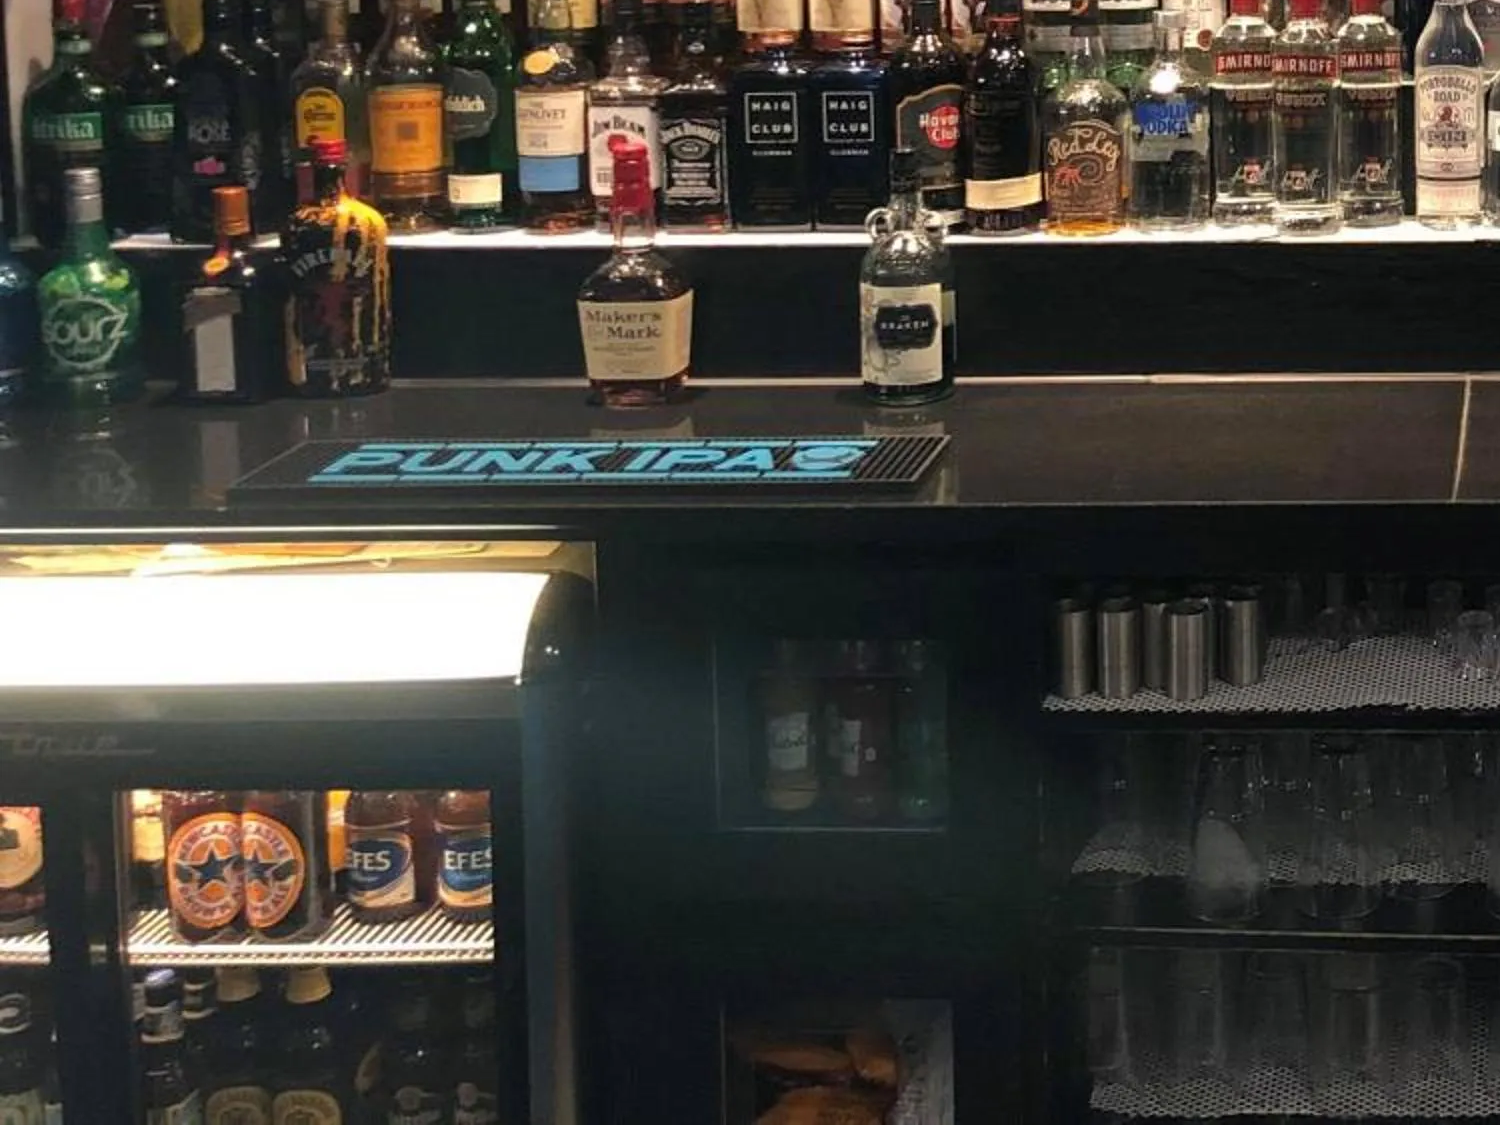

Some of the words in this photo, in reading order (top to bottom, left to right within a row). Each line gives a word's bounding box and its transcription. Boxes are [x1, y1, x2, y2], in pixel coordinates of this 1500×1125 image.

[1218, 54, 1271, 71] SMIRNO
[1433, 90, 1461, 101] ROAD
[752, 101, 791, 111] HAIG
[828, 100, 868, 110] HAIG
[752, 124, 792, 134] CLUB
[829, 122, 868, 132] CLUB
[607, 325, 661, 340] Mark
[322, 445, 597, 474] PUNK
[626, 445, 772, 474] IPA
